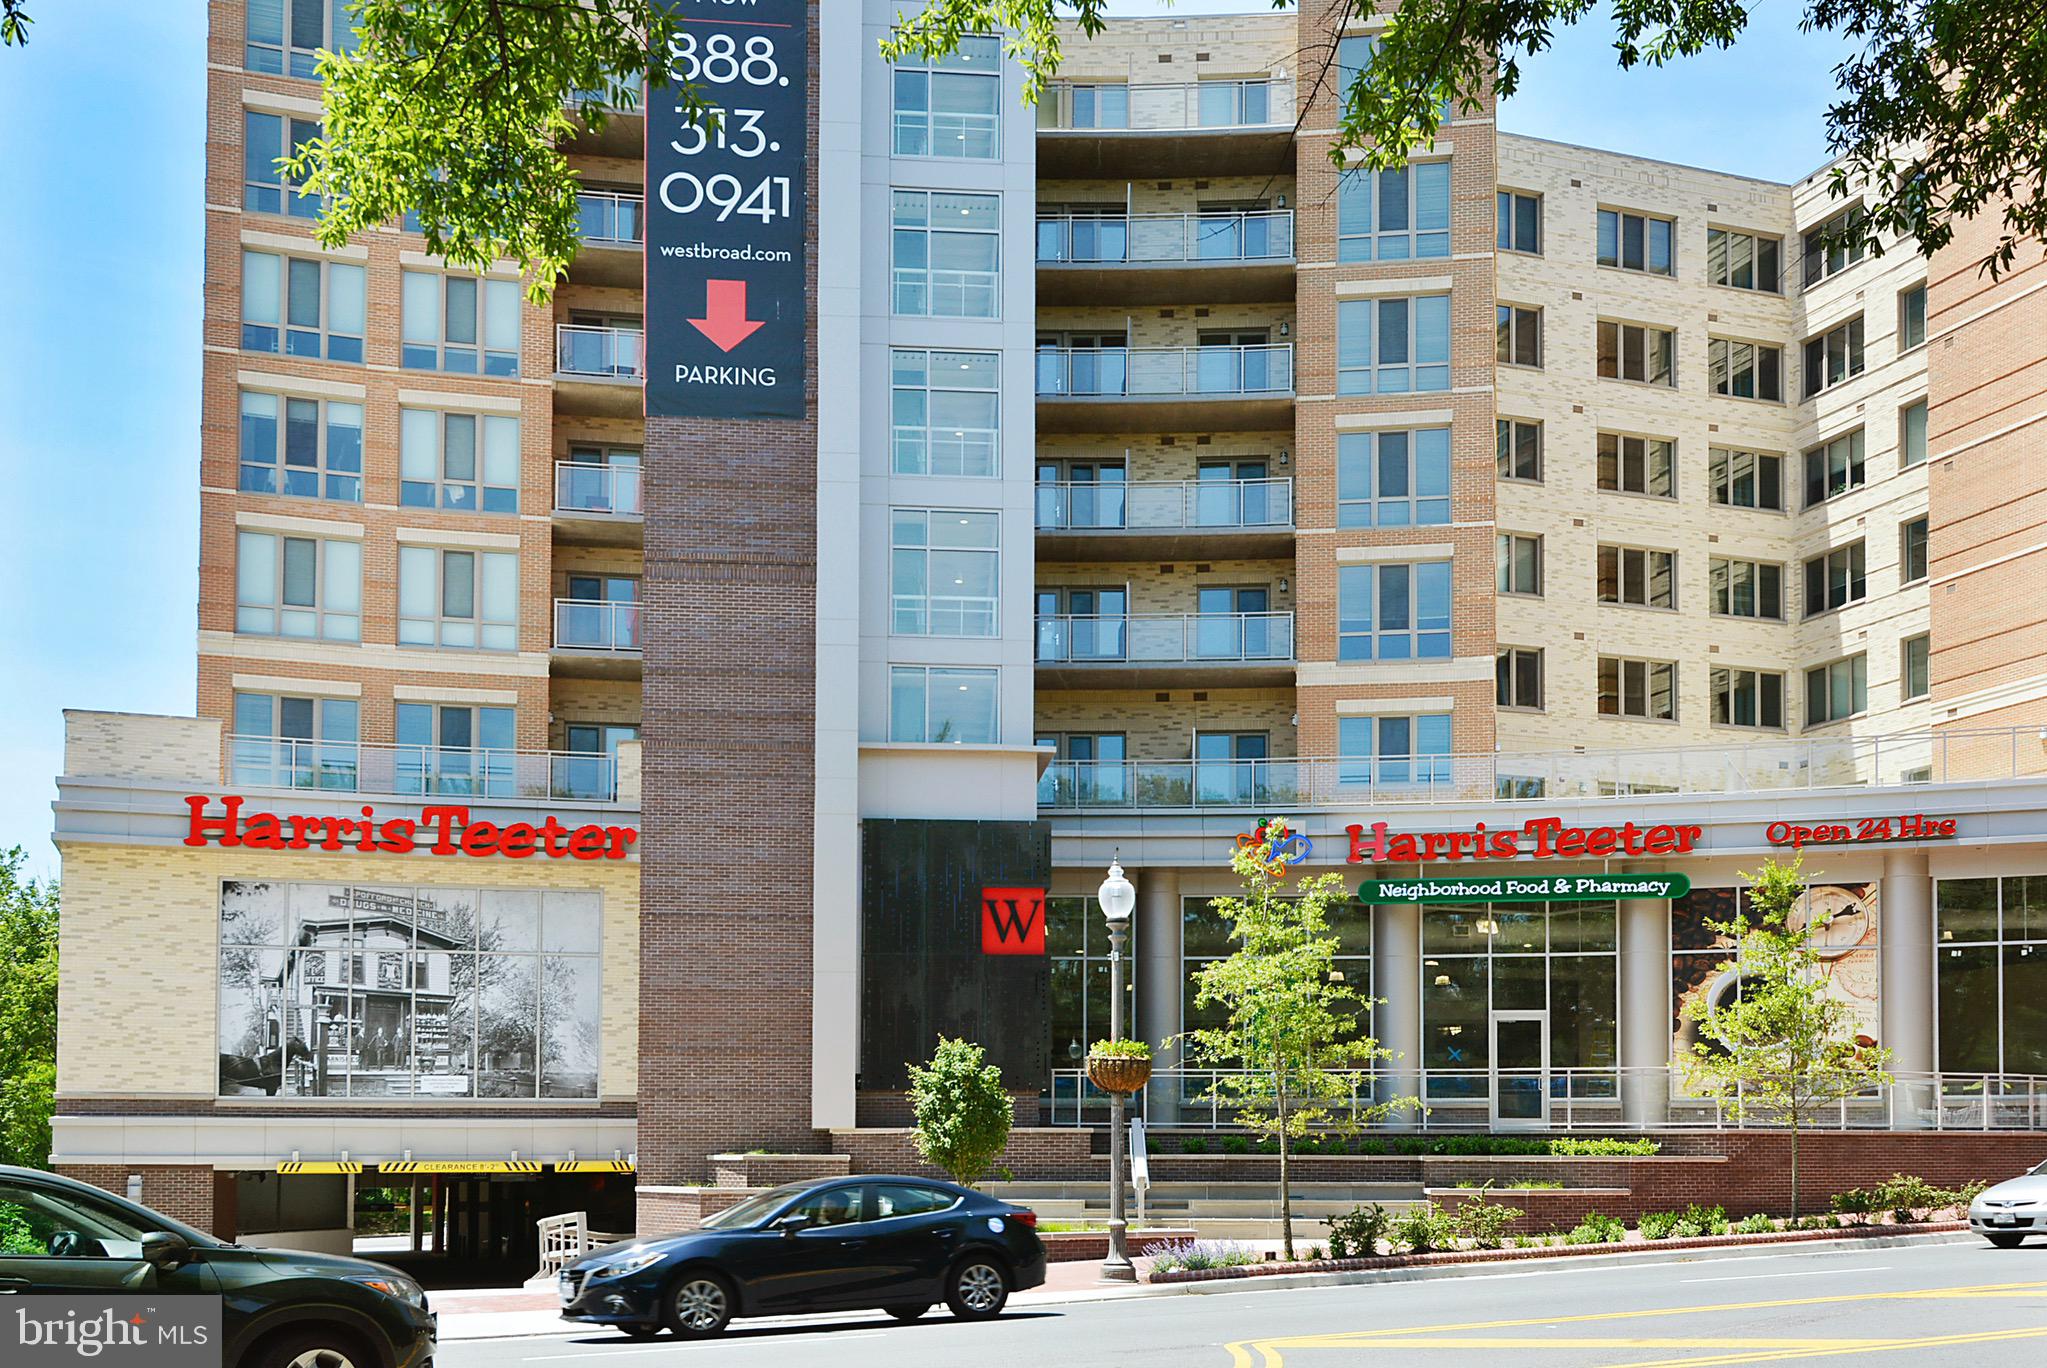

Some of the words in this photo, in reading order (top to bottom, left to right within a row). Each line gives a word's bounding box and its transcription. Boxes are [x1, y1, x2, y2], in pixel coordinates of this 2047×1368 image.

[664, 31, 790, 88] 888.
[670, 105, 781, 158] 313.
[659, 171, 790, 224] 0941
[660, 242, 792, 262] westbroad.com
[675, 364, 776, 387] PARKING
[183, 795, 416, 854] Harris
[422, 805, 638, 859] Teeter
[1345, 820, 1519, 865] Harris
[1523, 815, 1702, 860] Teeter
[1766, 821, 1852, 849] Open
[1856, 818, 1892, 840] 24
[1898, 813, 1957, 838] Hrs
[340, 898, 376, 911] DUGS
[392, 906, 438, 920] MEDCINE
[1379, 880, 1504, 901] Neighborhood
[1506, 879, 1552, 895] Food
[1554, 878, 1573, 894] &
[1575, 877, 1671, 897] Pharmacy
[985, 899, 1041, 944] W
[423, 1162, 479, 1171] CLEARANCE
